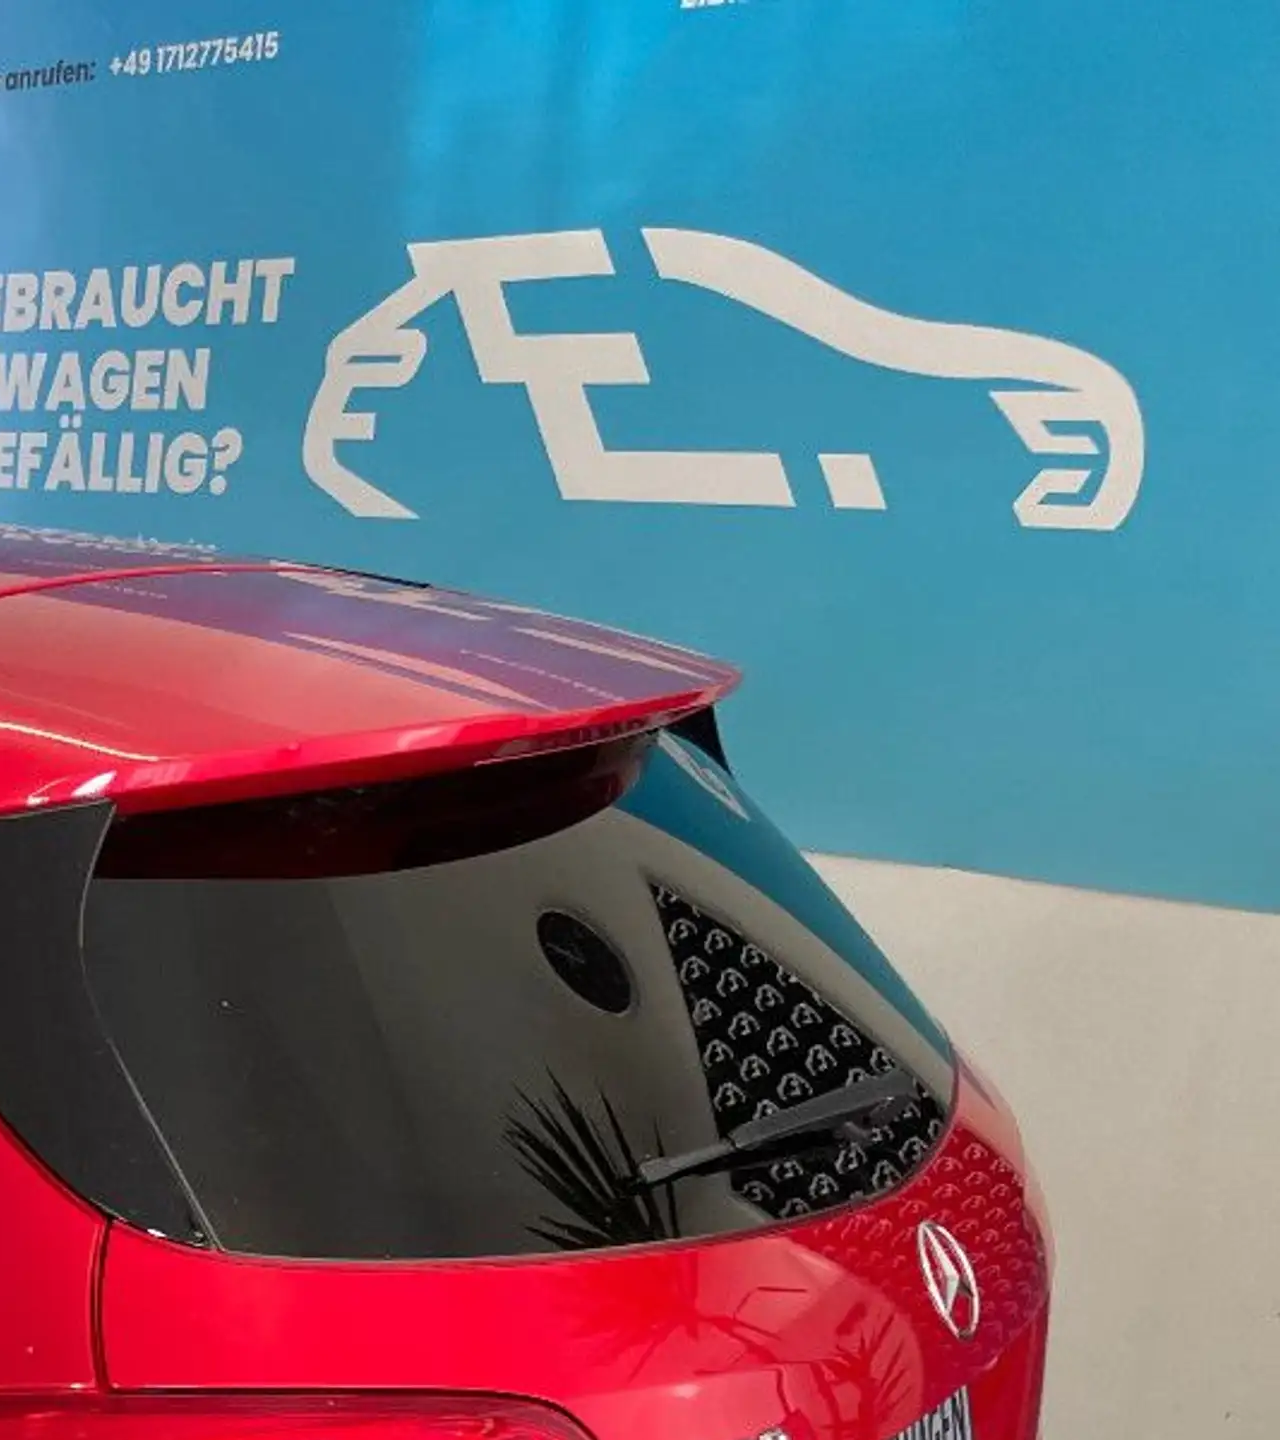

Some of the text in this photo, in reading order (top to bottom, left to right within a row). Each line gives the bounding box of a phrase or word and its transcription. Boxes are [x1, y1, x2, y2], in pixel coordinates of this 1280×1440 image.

[6, 60, 96, 91] anrufen:
[109, 49, 151, 77] +49
[156, 31, 279, 74] 1712775415
